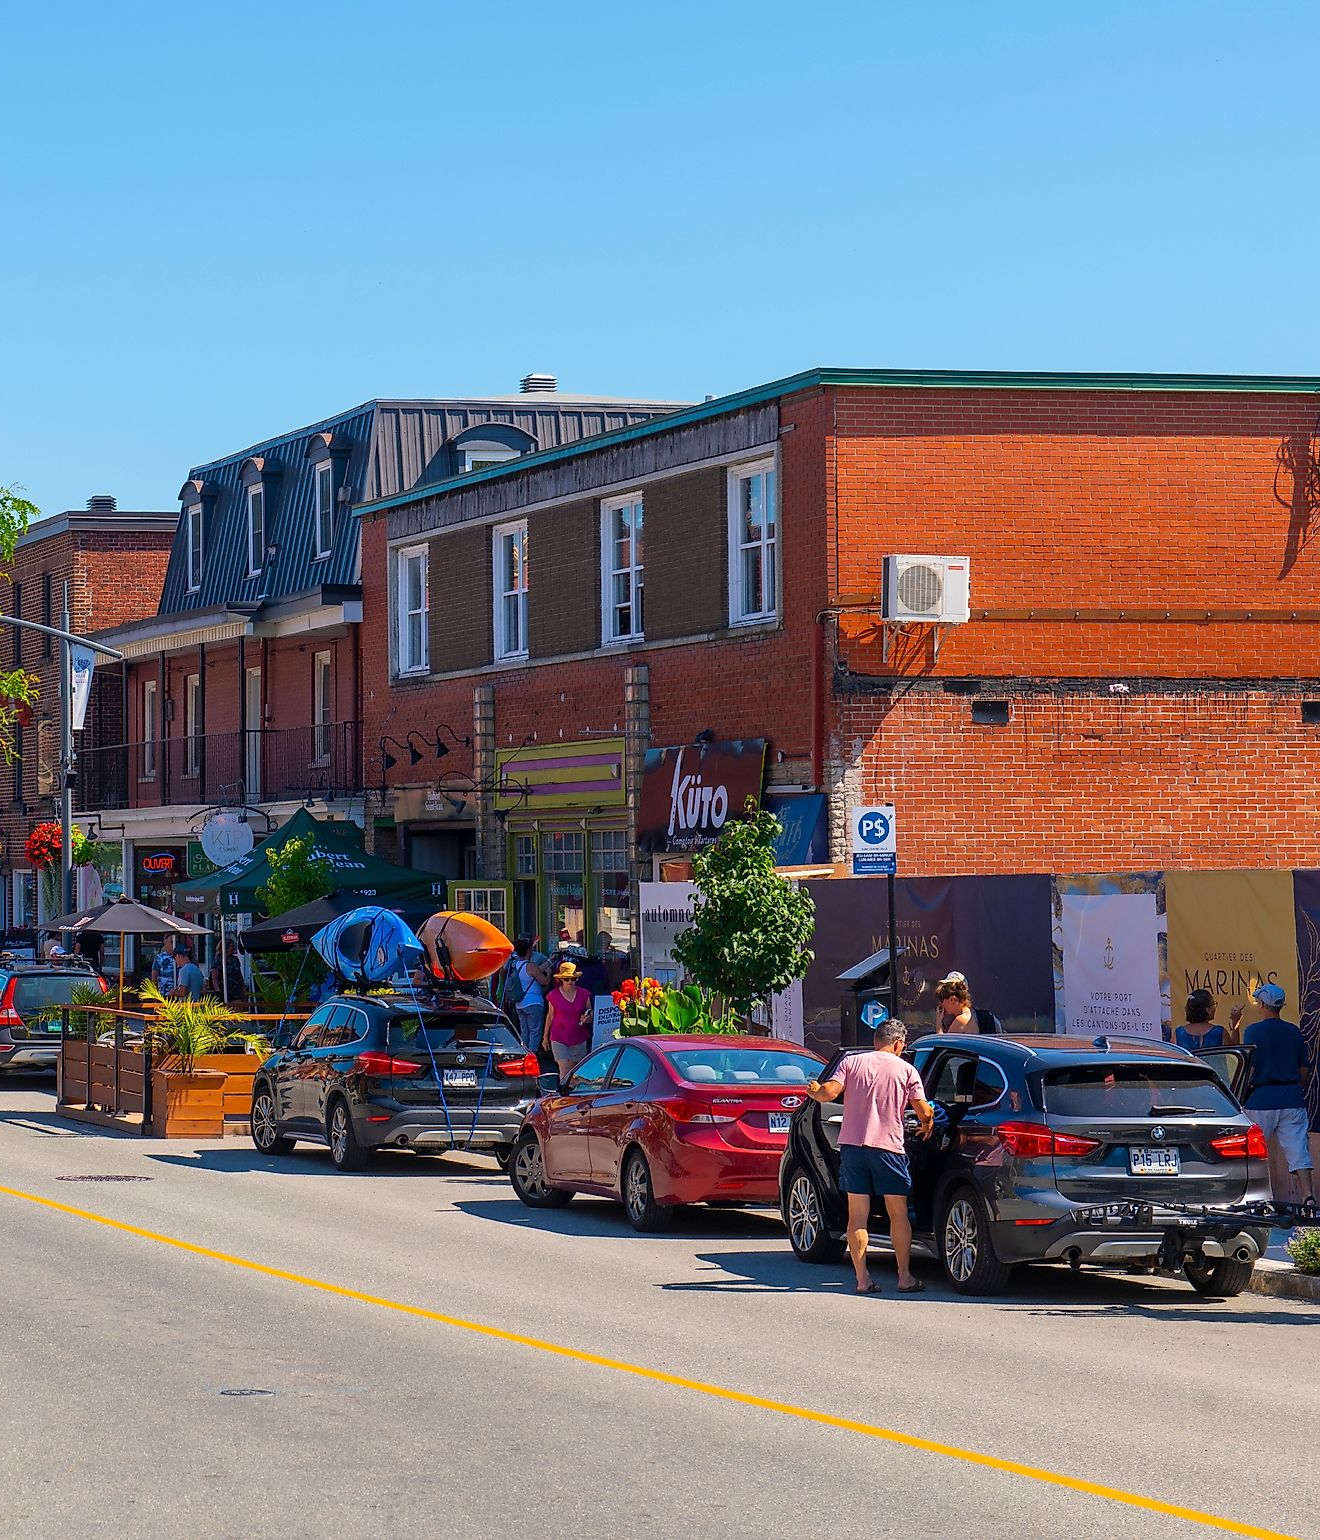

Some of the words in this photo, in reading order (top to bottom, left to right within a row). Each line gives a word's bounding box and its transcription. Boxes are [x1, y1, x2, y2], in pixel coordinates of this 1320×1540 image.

[667, 749, 728, 836] KÜTO
[862, 818, 886, 839] P$
[306, 849, 350, 862] ubert
[142, 857, 174, 870] OUVERT
[644, 904, 694, 923] automne
[871, 935, 940, 959] MINAS
[1204, 952, 1236, 962] QUARTIER
[1240, 953, 1253, 962] DES
[1090, 991, 1112, 1002] VOTRE
[1114, 993, 1132, 1002] PORT
[867, 1005, 885, 1025] P
[1083, 1005, 1119, 1016] D'ATTACHE
[1122, 1008, 1141, 1017] DANS
[1072, 1019, 1084, 1028] LES
[1087, 1020, 1153, 1032] CANTONS-DE-L'EST
[770, 1117, 787, 1128] N12
[1133, 1153, 1152, 1167] P15
[1158, 1153, 1178, 1167] LRJ
[1178, 1218, 1199, 1226] THULE
